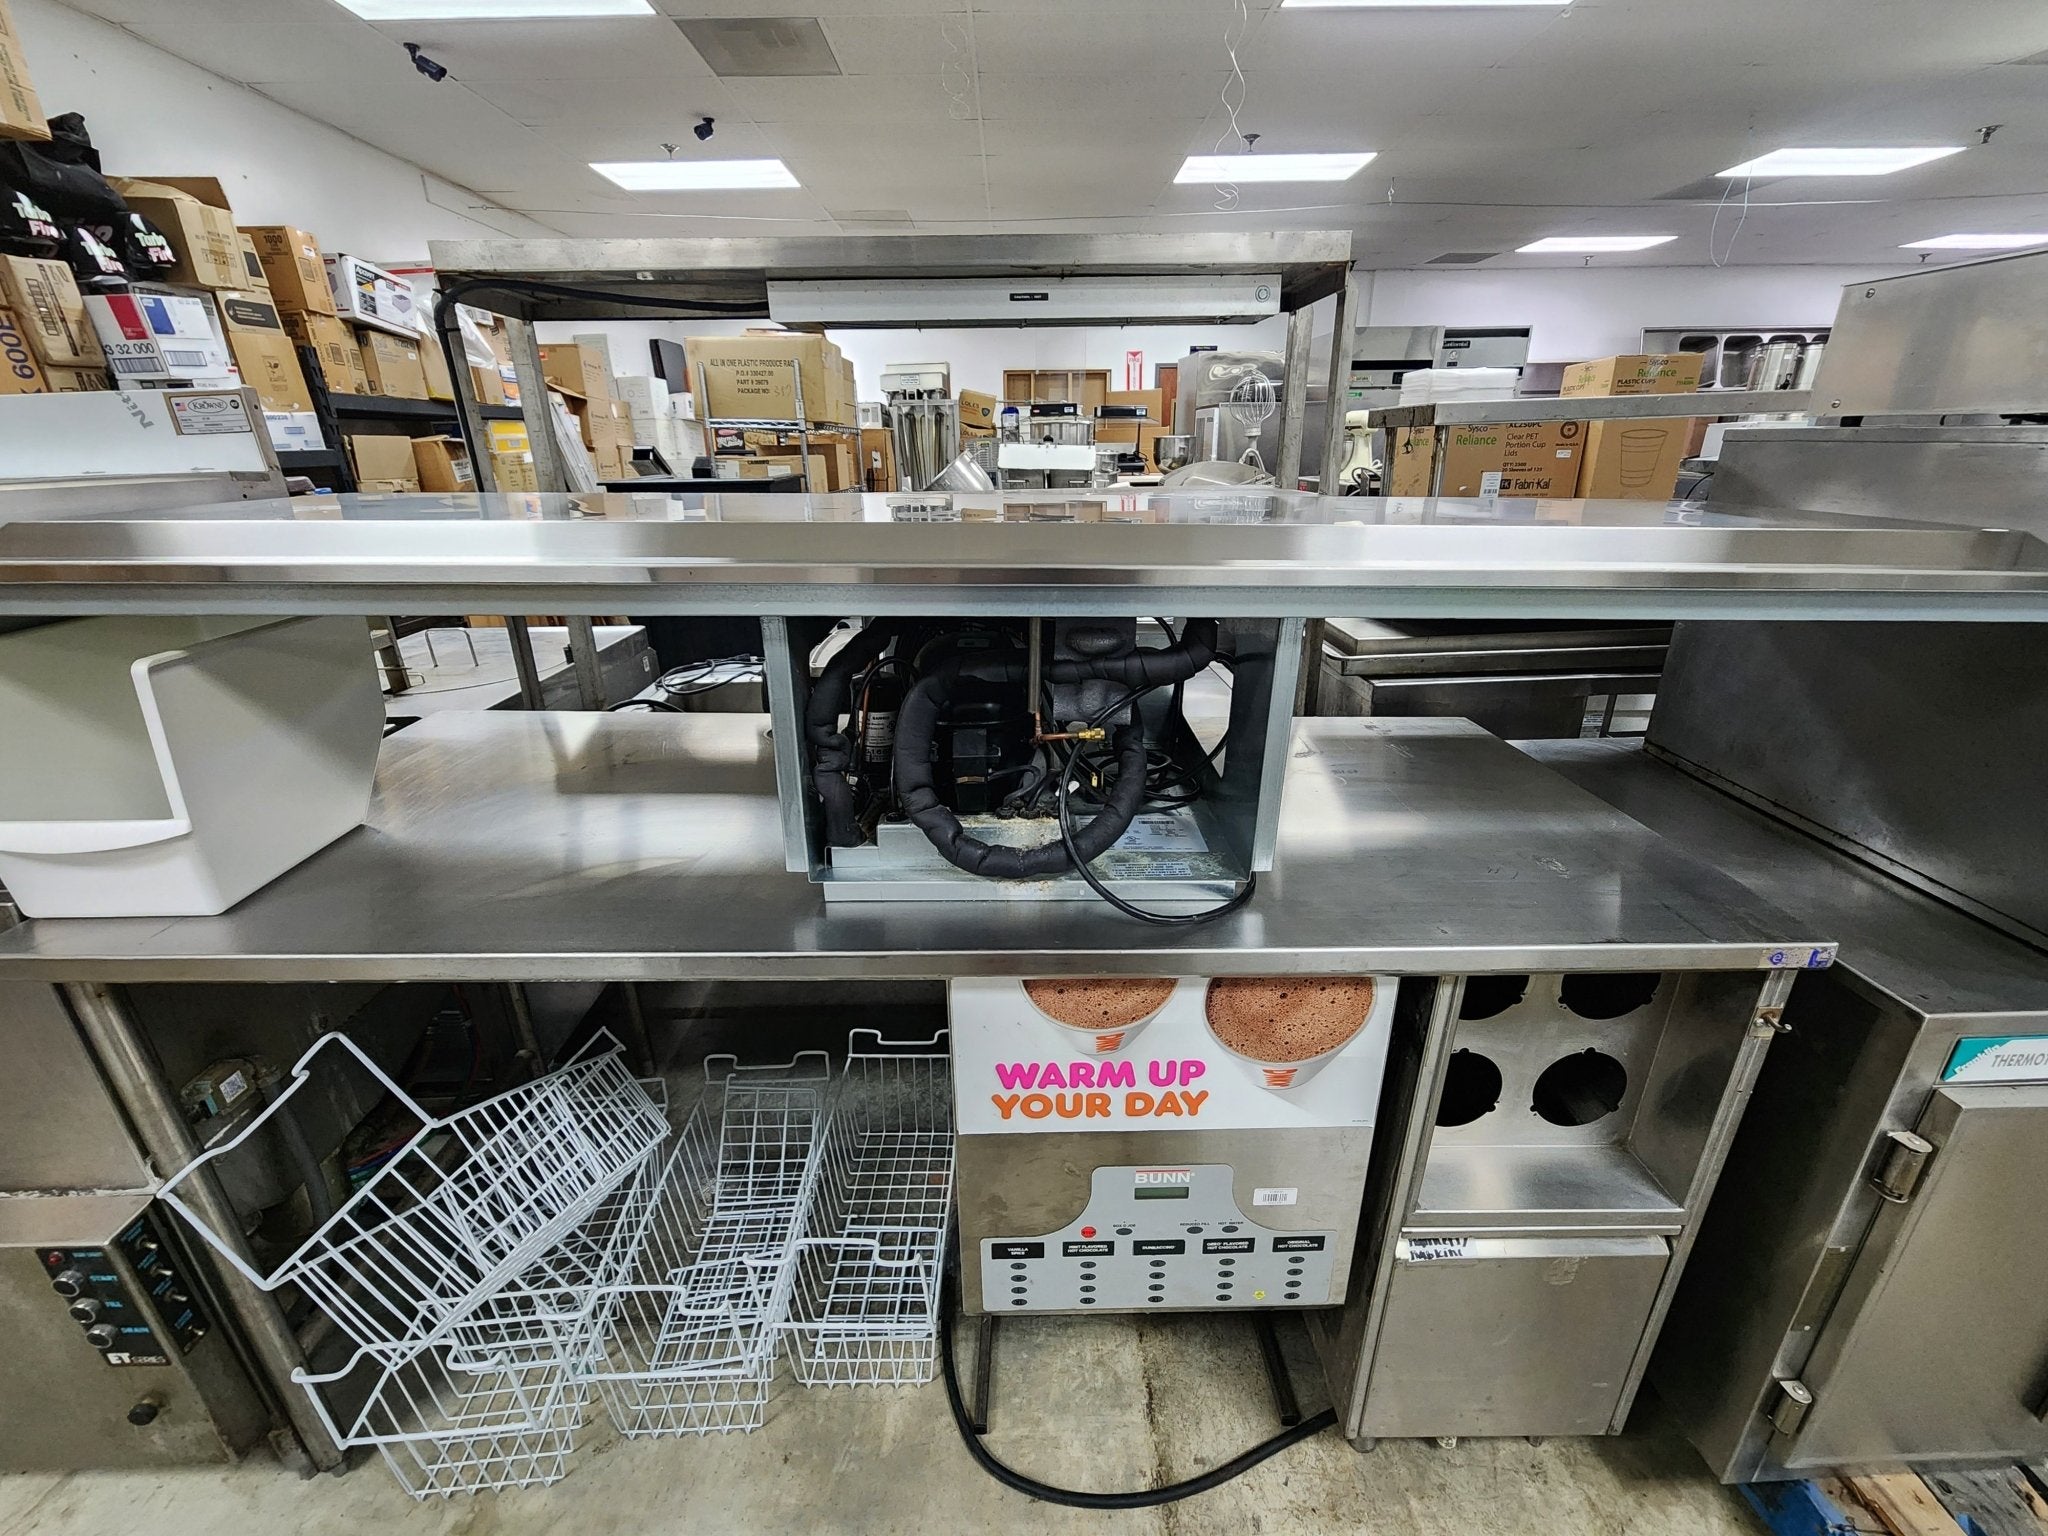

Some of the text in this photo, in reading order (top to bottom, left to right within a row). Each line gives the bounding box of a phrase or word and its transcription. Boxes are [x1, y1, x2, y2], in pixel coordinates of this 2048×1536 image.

[118, 343, 132, 354] 32
[133, 342, 155, 354] 000
[710, 359, 719, 367] ALL
[1468, 424, 1488, 433] Sysco
[1455, 434, 1497, 446] Reliance
[1526, 432, 1539, 440] PET
[1504, 449, 1518, 457] Lids
[1953, 1044, 2000, 1074] Franklin
[995, 1060, 1206, 1090] WARM UP
[991, 1090, 1209, 1120] YOUR DAY
[1134, 1172, 1191, 1184] BUNN
[107, 1352, 131, 1364] ET
